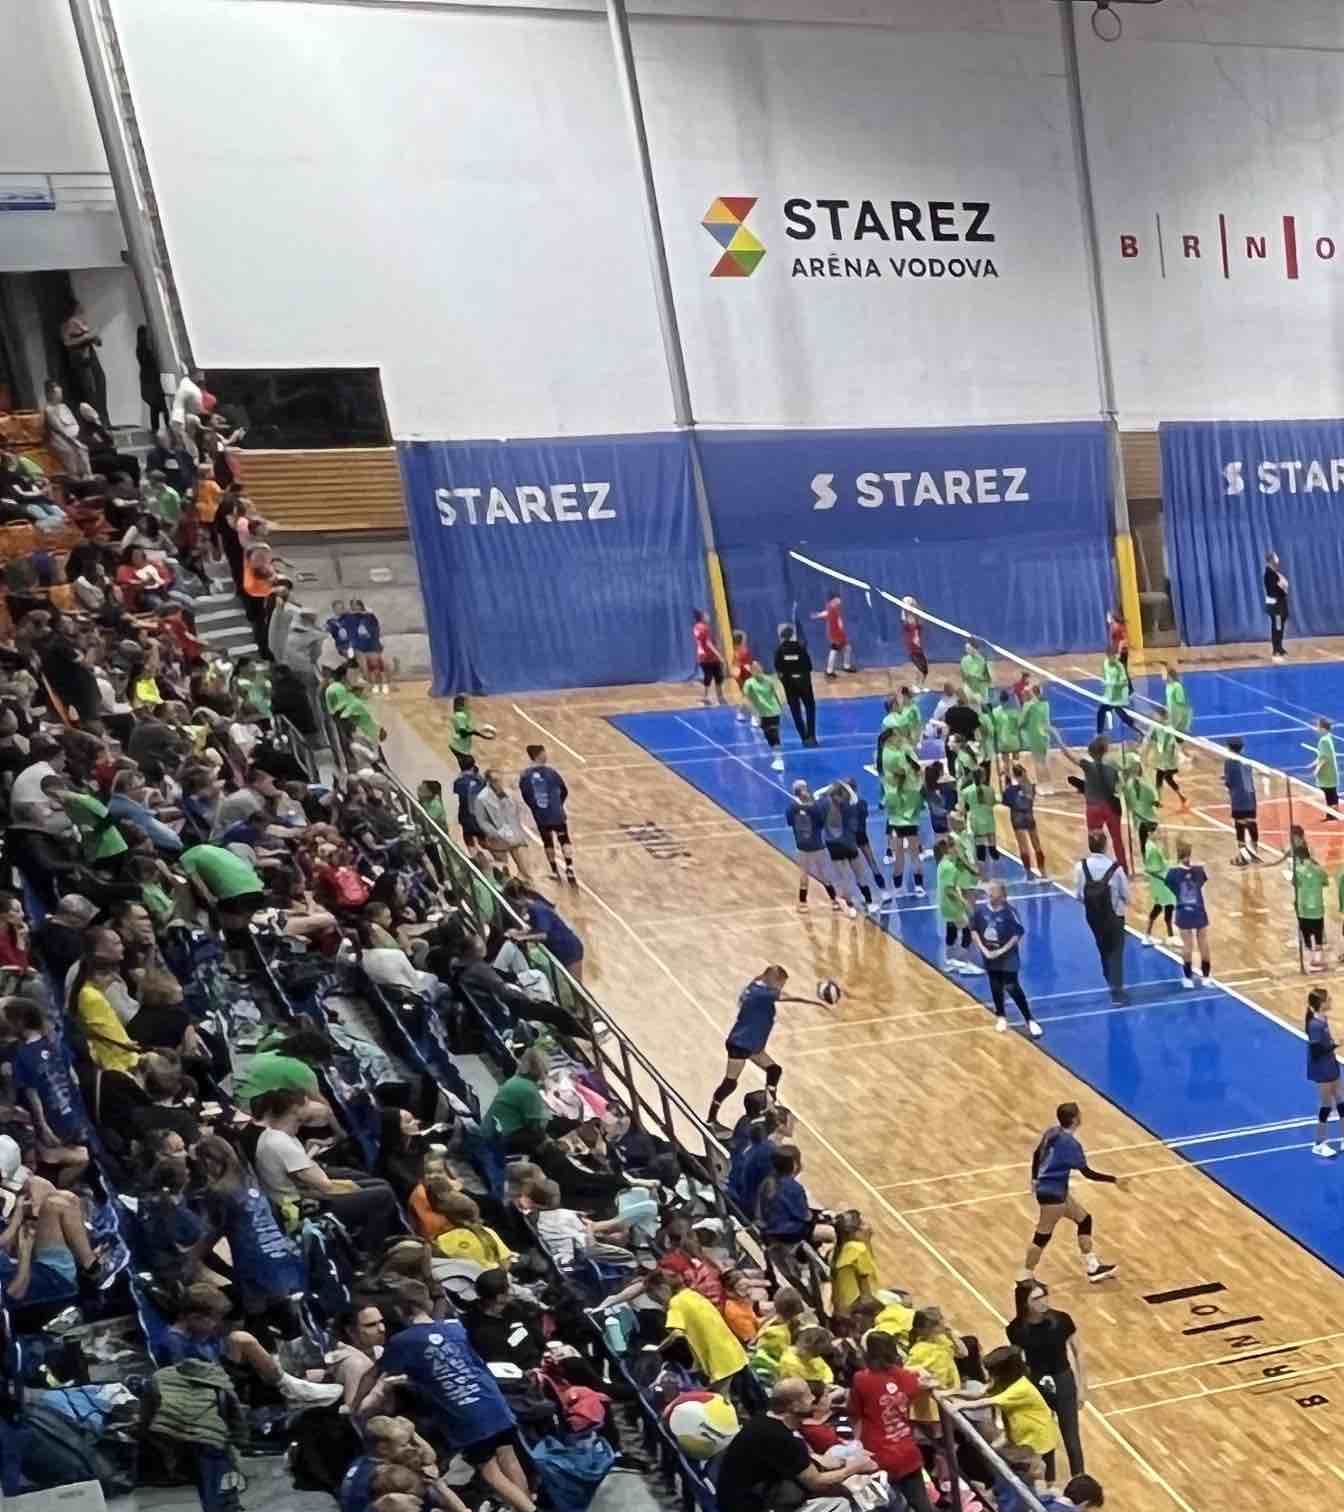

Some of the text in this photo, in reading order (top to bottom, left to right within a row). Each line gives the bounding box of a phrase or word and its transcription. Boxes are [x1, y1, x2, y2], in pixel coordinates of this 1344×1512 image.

[783, 197, 996, 243] STAREZ
[791, 251, 1000, 279] ARÉNA VODOVA
[435, 481, 617, 529] STAREZ
[856, 466, 1030, 508] STAREZ
